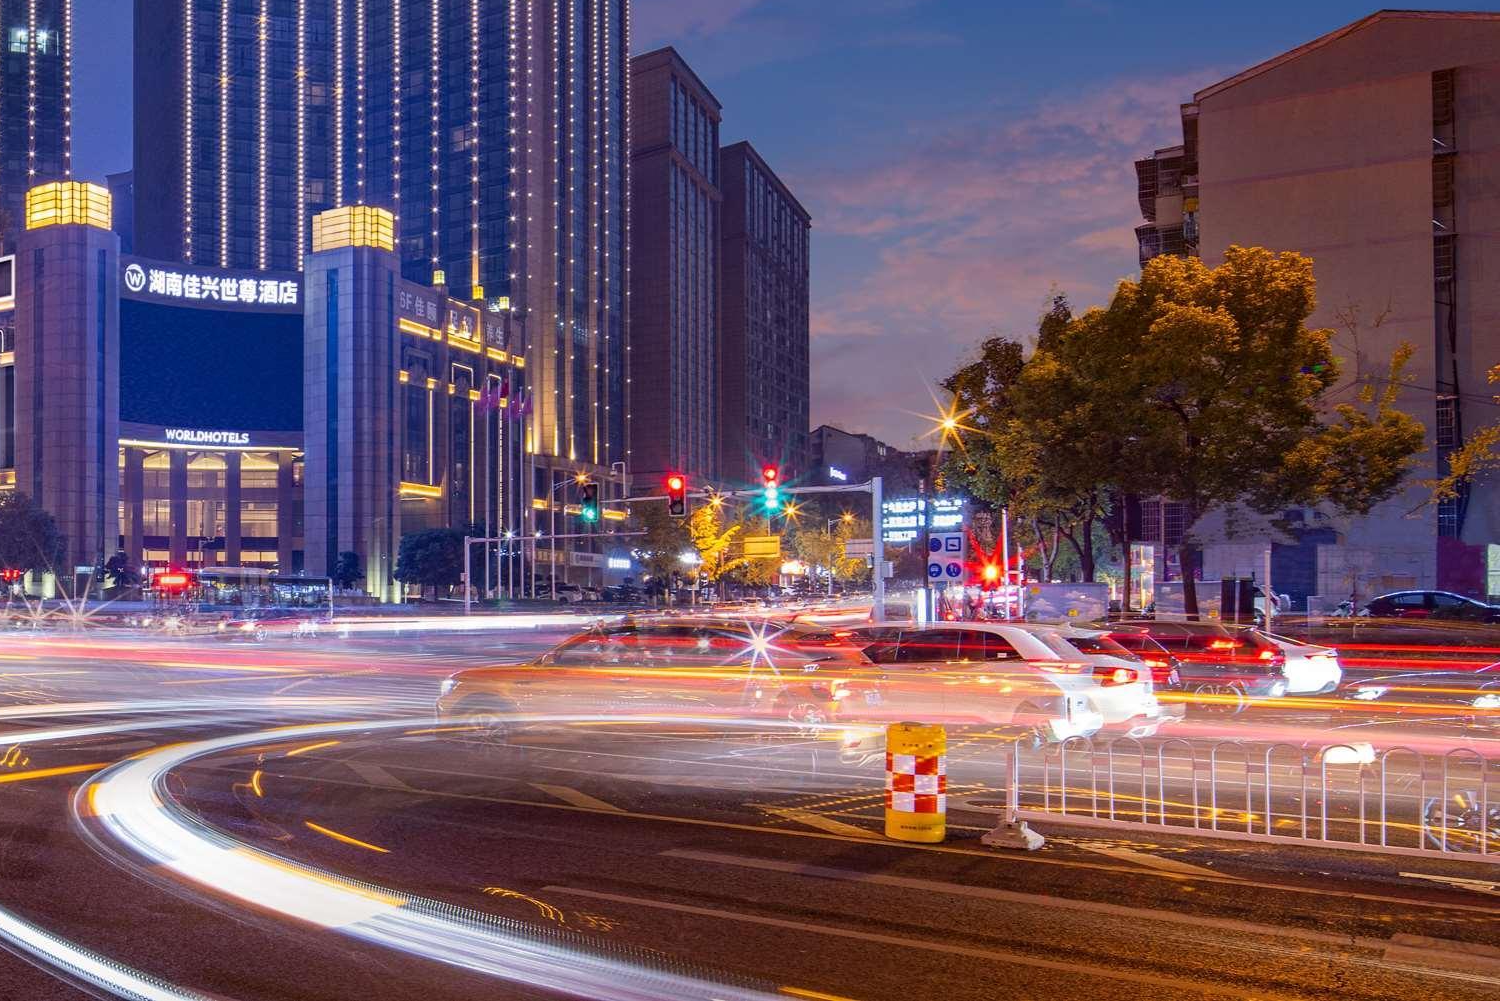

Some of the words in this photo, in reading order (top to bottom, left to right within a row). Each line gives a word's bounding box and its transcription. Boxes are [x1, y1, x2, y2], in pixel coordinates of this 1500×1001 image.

[149, 269, 298, 304] 湖南佳兴世尊酒店
[165, 428, 250, 444] WORLDHOTELS
